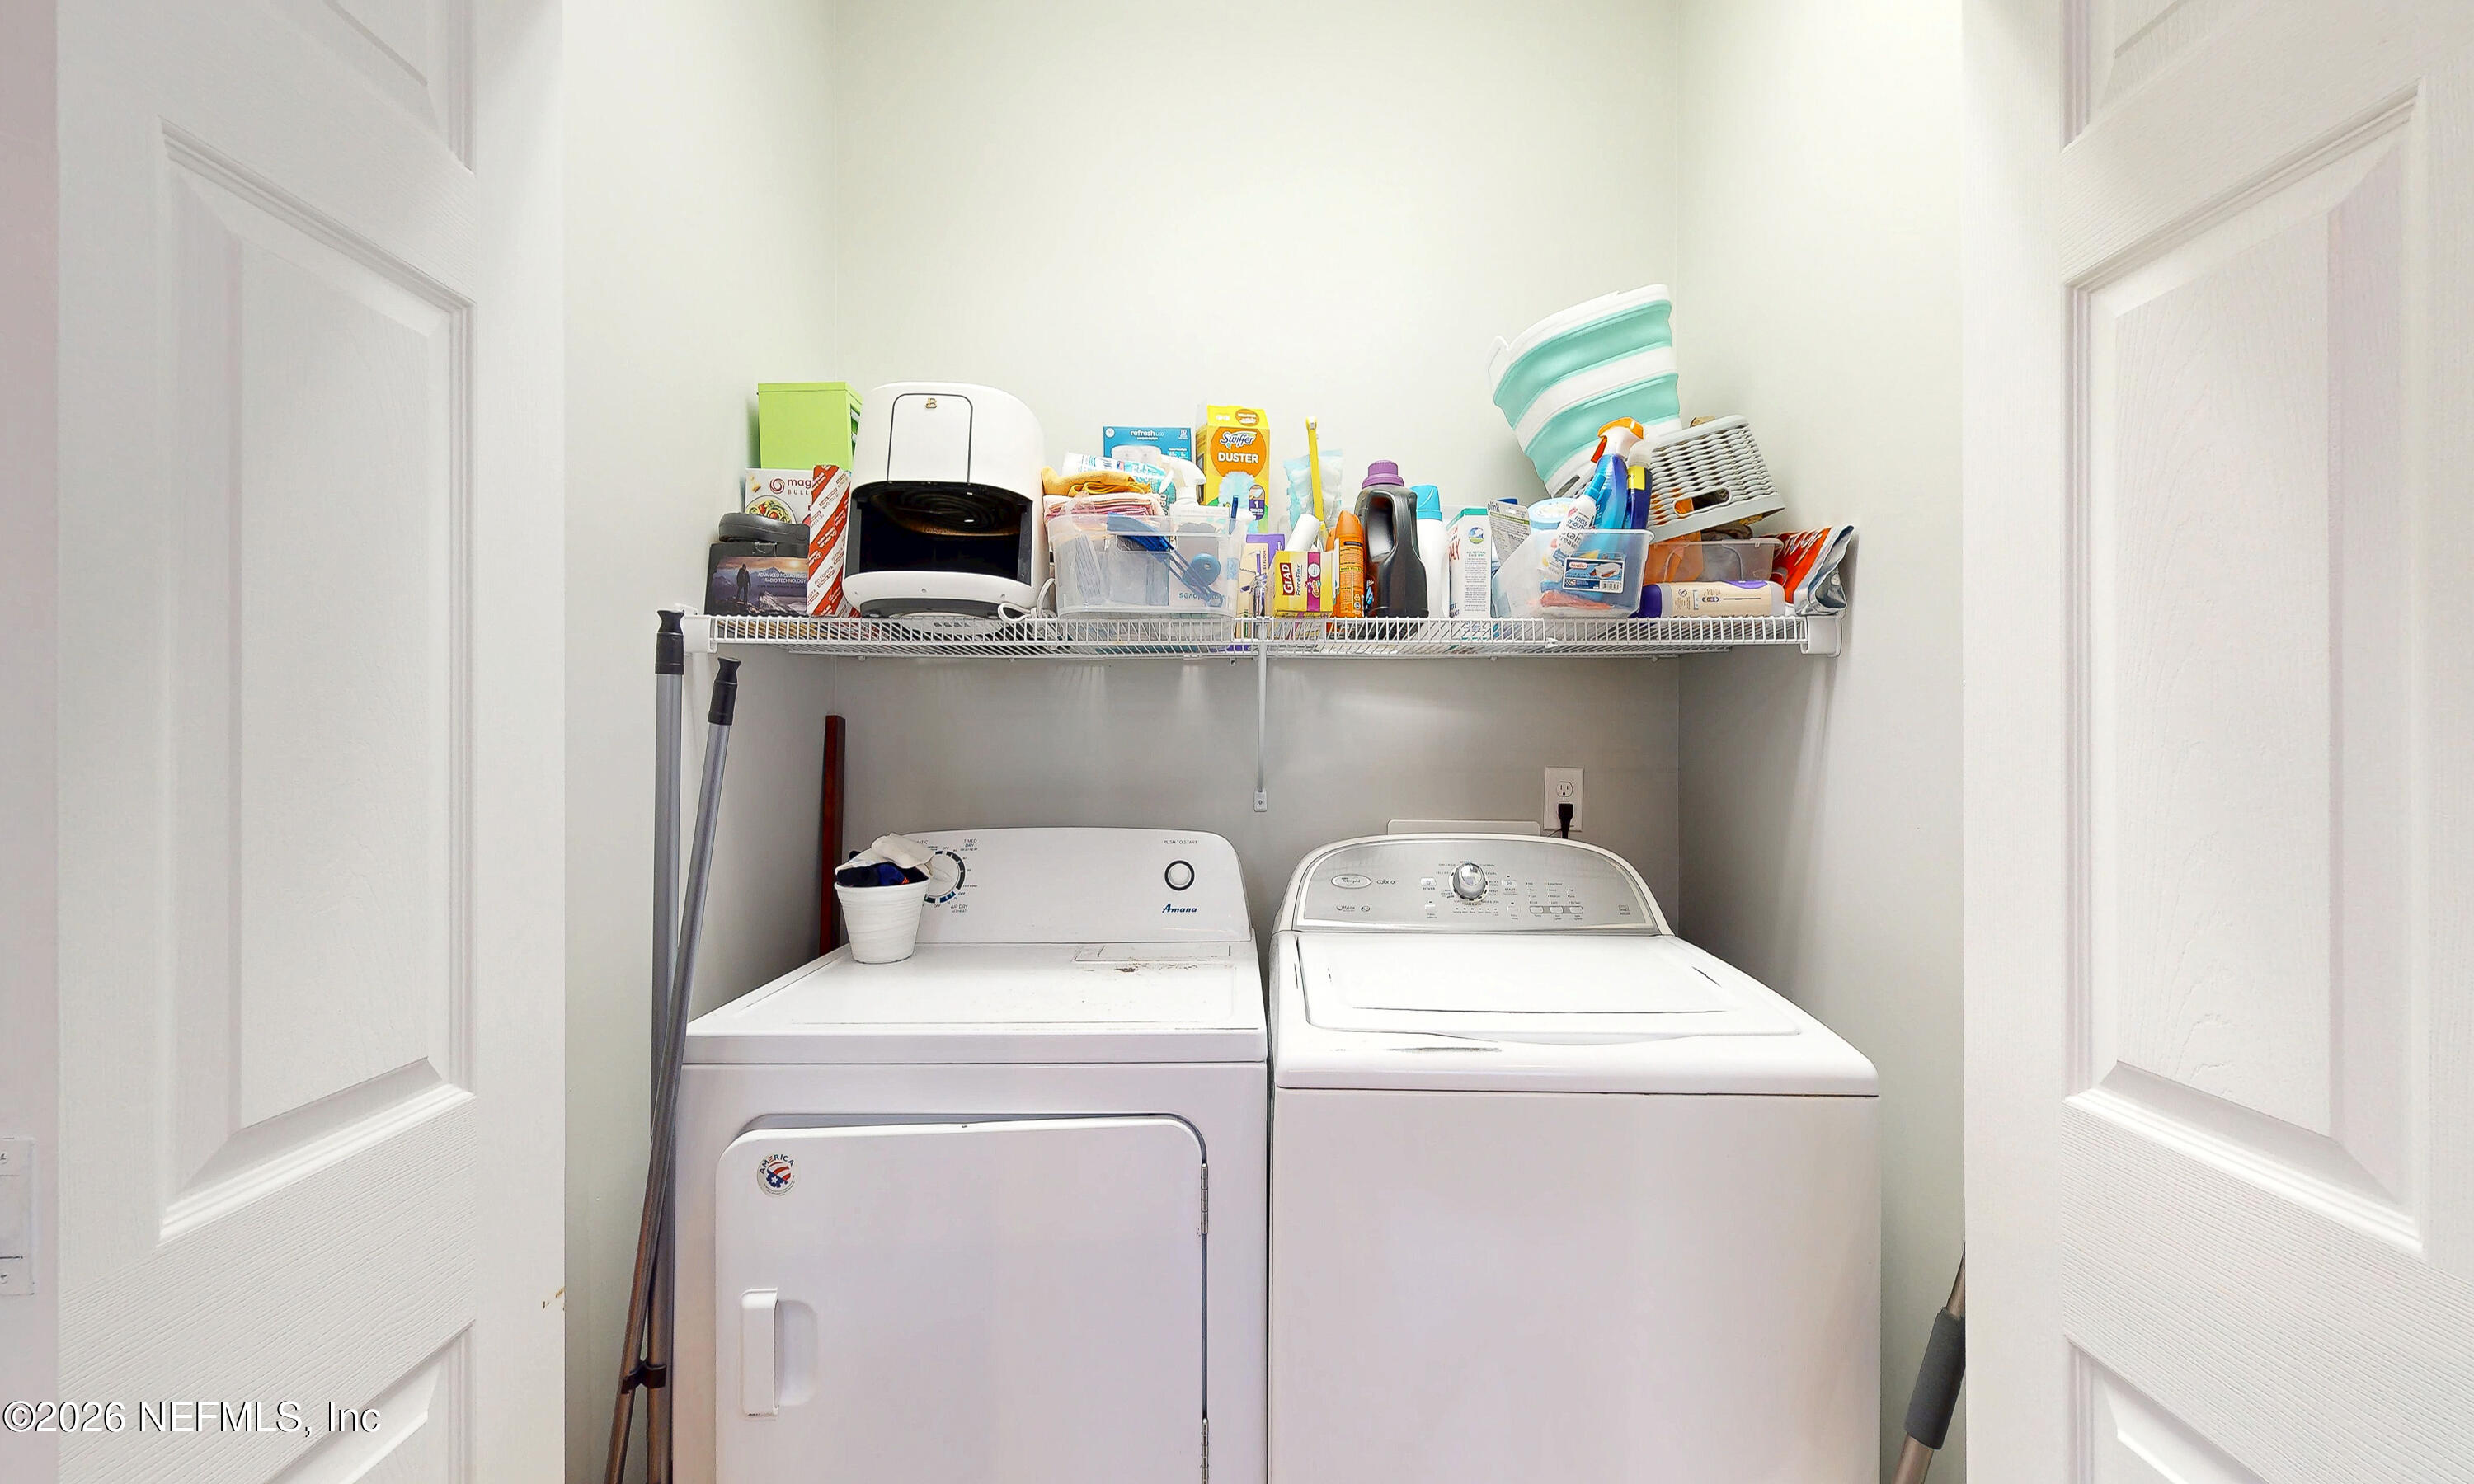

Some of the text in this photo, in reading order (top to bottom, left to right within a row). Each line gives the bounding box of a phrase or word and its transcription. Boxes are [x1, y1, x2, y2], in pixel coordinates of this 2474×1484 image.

[1220, 431, 1255, 448] Swiffer
[1218, 452, 1259, 463] DUSTER
[788, 479, 811, 488] mag
[1254, 500, 1259, 509] 1
[1574, 515, 1587, 527] miss
[1281, 564, 1294, 594] GLAD
[1162, 903, 1197, 913] Amana
[759, 1154, 794, 1175] AMERICA
